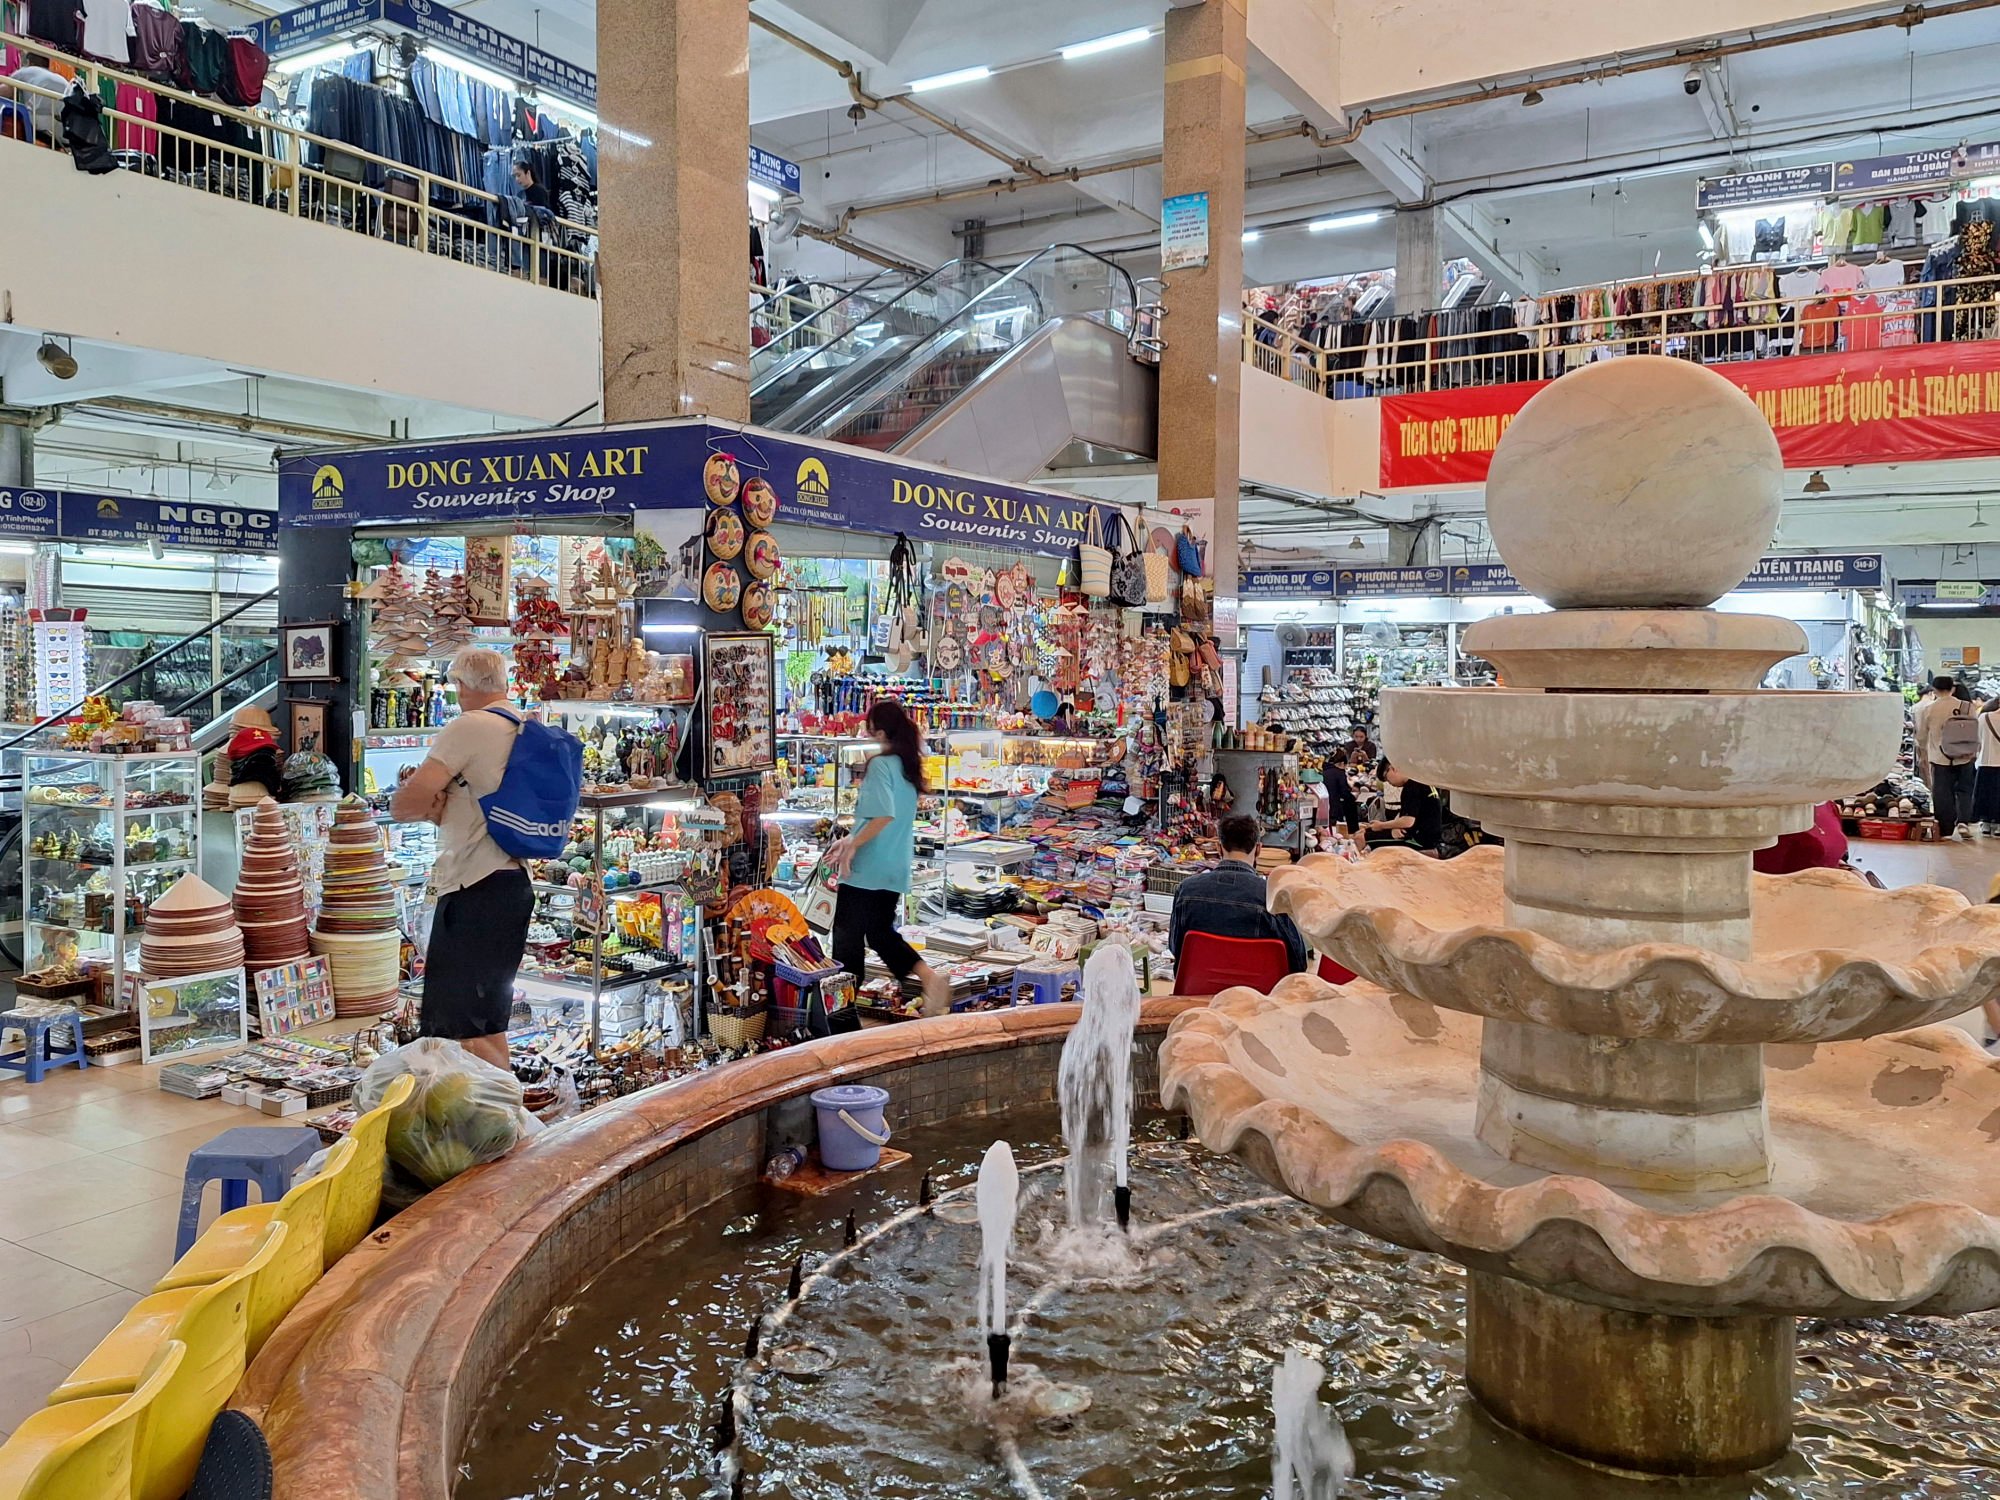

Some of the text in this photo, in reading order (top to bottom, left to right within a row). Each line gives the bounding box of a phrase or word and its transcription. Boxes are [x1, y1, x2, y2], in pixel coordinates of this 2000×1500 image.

[292, 8, 316, 27] THÌN
[448, 13, 521, 56] THÌN
[1746, 172, 1782, 184] OANH
[1872, 167, 1891, 179] BÁN
[1893, 163, 1920, 175] BUÔN
[1780, 386, 1820, 427] NINH
[1825, 367, 1846, 424] TỔ
[1849, 365, 1893, 426] QUỐC
[1898, 369, 1919, 418] LÀ
[1924, 366, 1980, 416] TRÁCH
[1985, 371, 2000, 412] N
[1400, 415, 1428, 457] TÍCH
[1431, 416, 1457, 462] CỰC
[1460, 415, 1498, 453] THAM
[386, 446, 649, 490] DONG XUAN ART
[413, 483, 616, 511] Souvenirs Shop
[892, 478, 976, 515] DONG
[982, 495, 1050, 527] XUAN
[159, 505, 271, 529] NGỌC
[919, 512, 1079, 548] Souvenirs Shop
[1253, 573, 1288, 585] CƯỜNG
[1355, 571, 1398, 582] PHƯƠNG
[1400, 570, 1423, 580] NGA
[1794, 559, 1844, 574] TRANG
